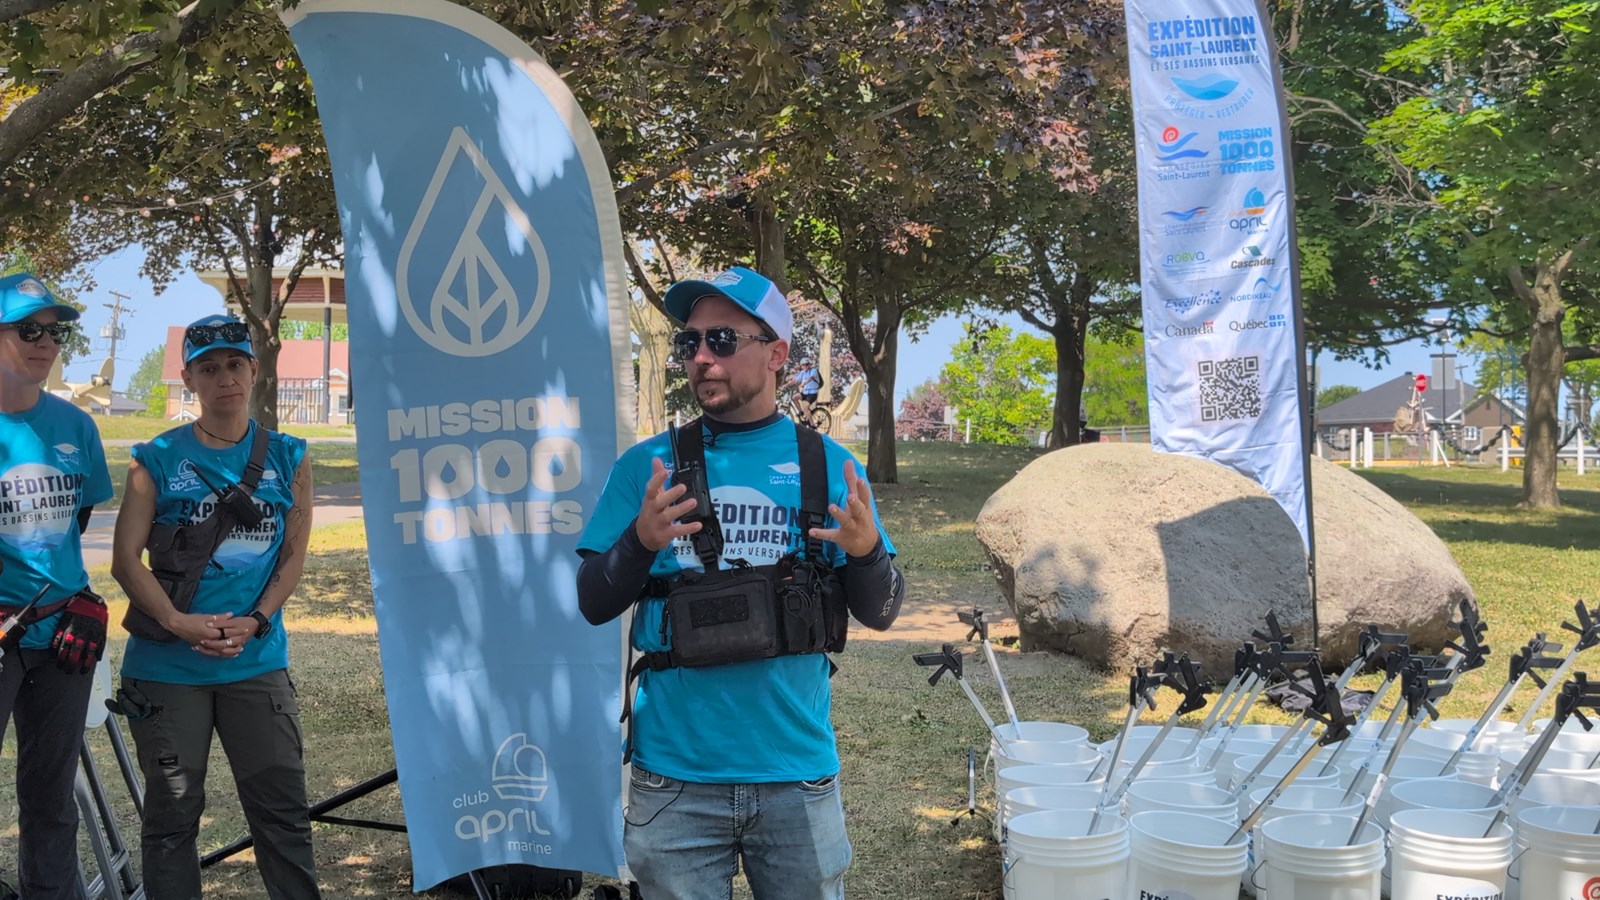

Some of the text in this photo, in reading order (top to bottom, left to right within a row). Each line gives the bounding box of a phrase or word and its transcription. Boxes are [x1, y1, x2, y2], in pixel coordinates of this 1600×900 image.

[1147, 15, 1256, 42] EXPÉDITION
[1151, 54, 1261, 72] ET SES BASSINS VERSANTS
[1217, 127, 1273, 142] MISSION
[1219, 140, 1274, 161] 1000
[1158, 170, 1210, 181] Saint-Laurent
[1220, 159, 1276, 175] TONNES
[1231, 257, 1276, 269] Cascades
[1165, 321, 1214, 338] Canada
[1229, 319, 1269, 332] Québec
[387, 396, 581, 441] MISSION
[390, 437, 582, 502] 1000
[11, 512, 49, 525] BASSINS
[393, 500, 583, 544] TONNES
[453, 790, 489, 808] club
[455, 807, 551, 843] april
[508, 840, 552, 855] marine
